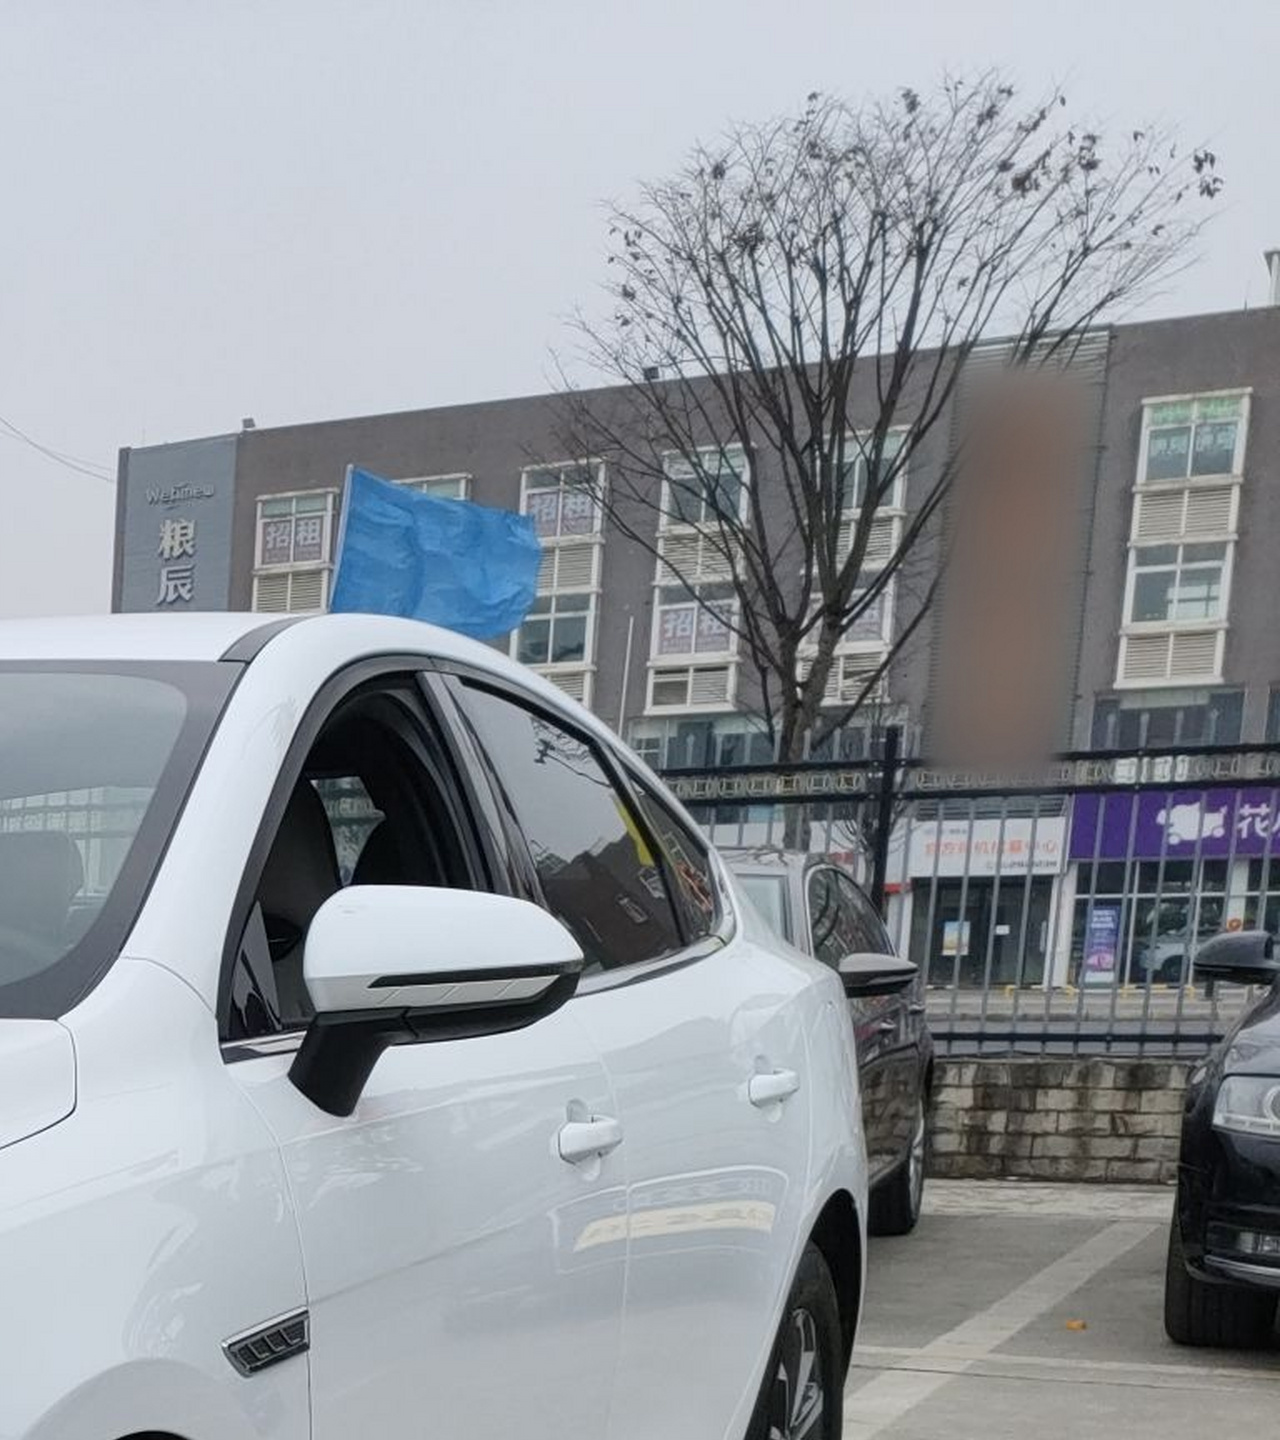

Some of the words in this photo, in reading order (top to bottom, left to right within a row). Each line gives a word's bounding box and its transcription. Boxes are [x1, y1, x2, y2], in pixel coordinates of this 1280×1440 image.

[266, 518, 323, 549] 招租
[158, 518, 196, 604] 粮辰
[664, 606, 732, 637] 招租
